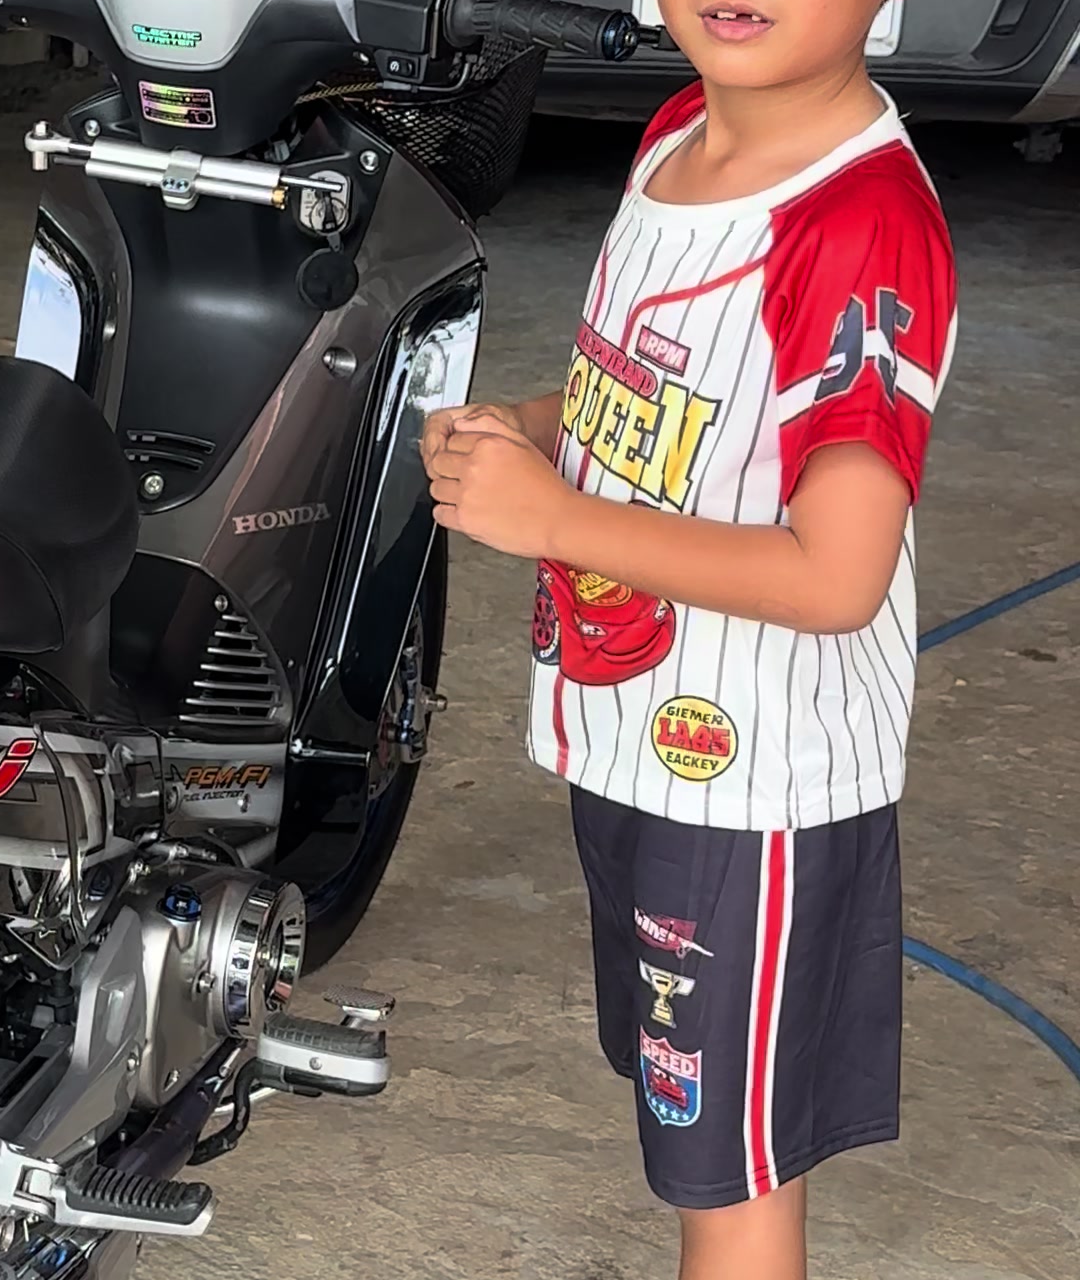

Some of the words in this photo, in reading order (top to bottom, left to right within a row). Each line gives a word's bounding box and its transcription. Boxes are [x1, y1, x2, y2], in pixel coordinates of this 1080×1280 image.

[562, 353, 723, 513] QUEEN
[232, 503, 331, 535] HONDA
[641, 1037, 696, 1075] SPEED
